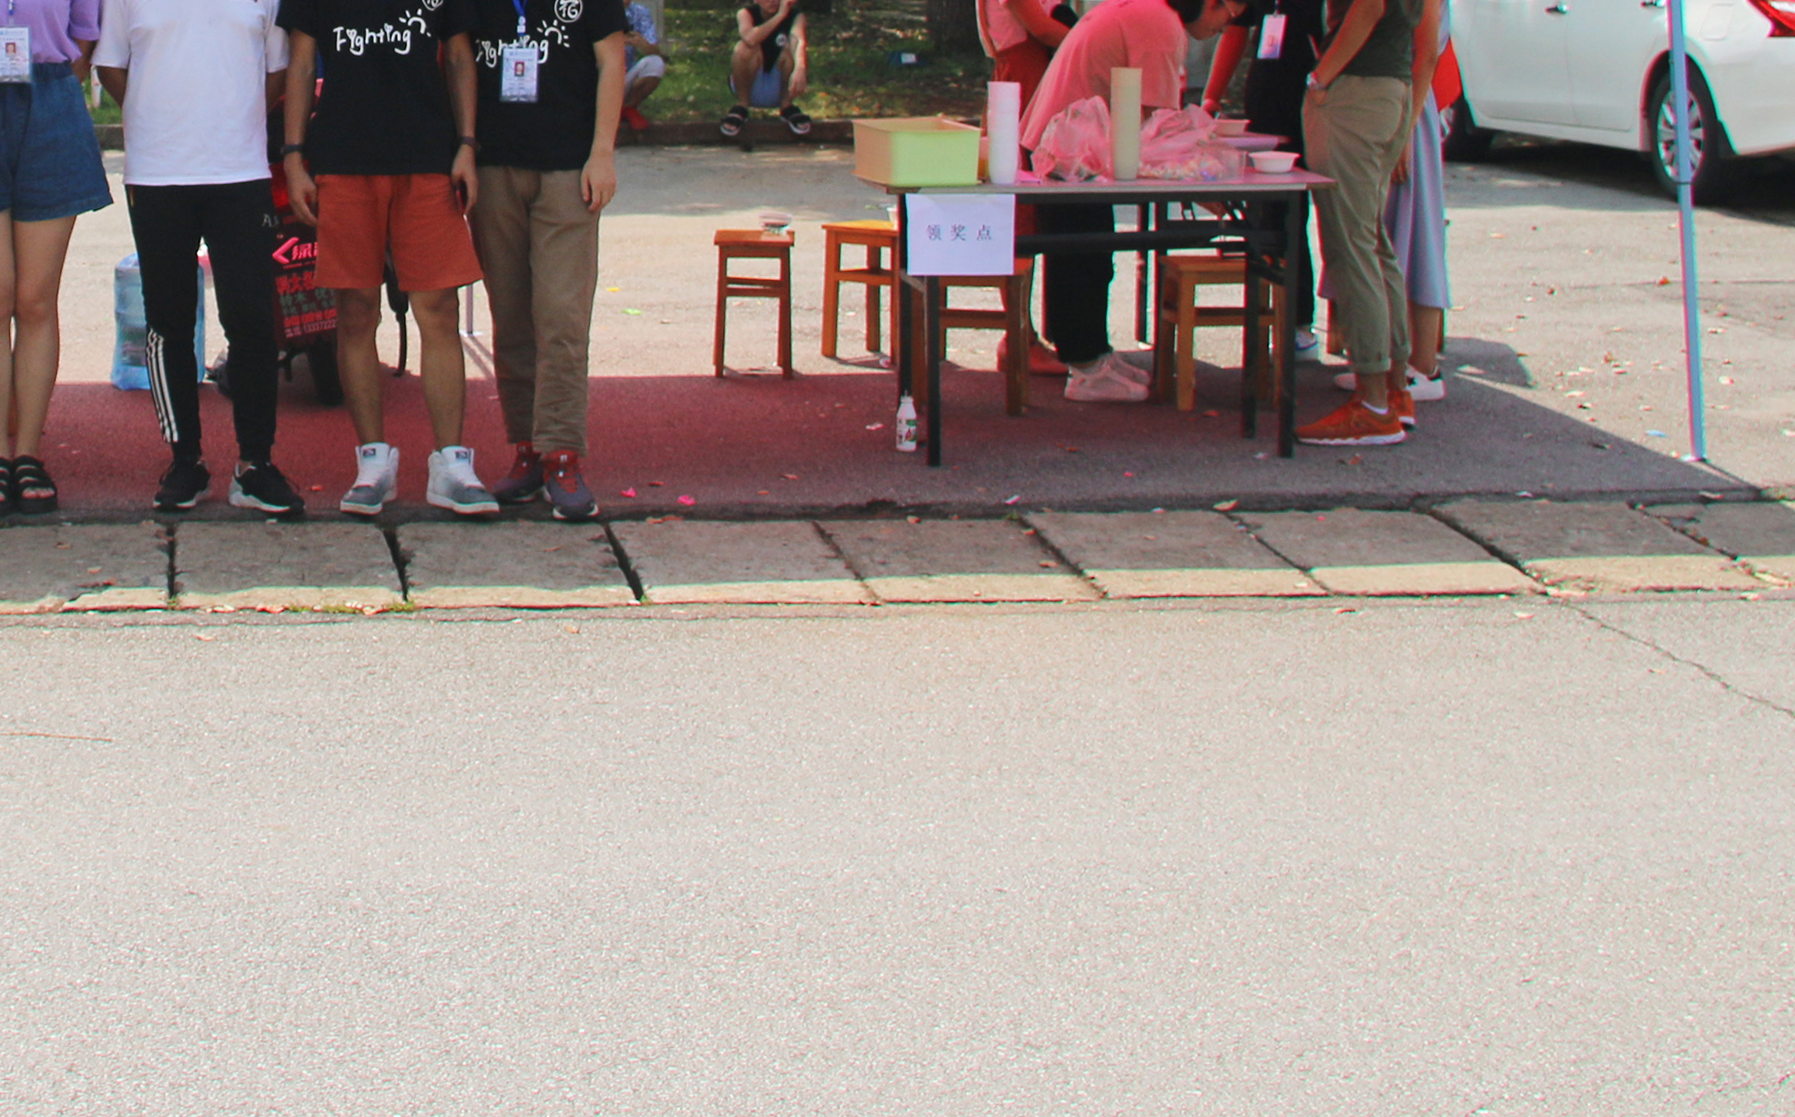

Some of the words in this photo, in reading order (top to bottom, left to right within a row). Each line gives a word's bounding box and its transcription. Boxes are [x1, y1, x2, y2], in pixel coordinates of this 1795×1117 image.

[333, 23, 411, 56] Fighting
[926, 224, 992, 241] 领奖点
